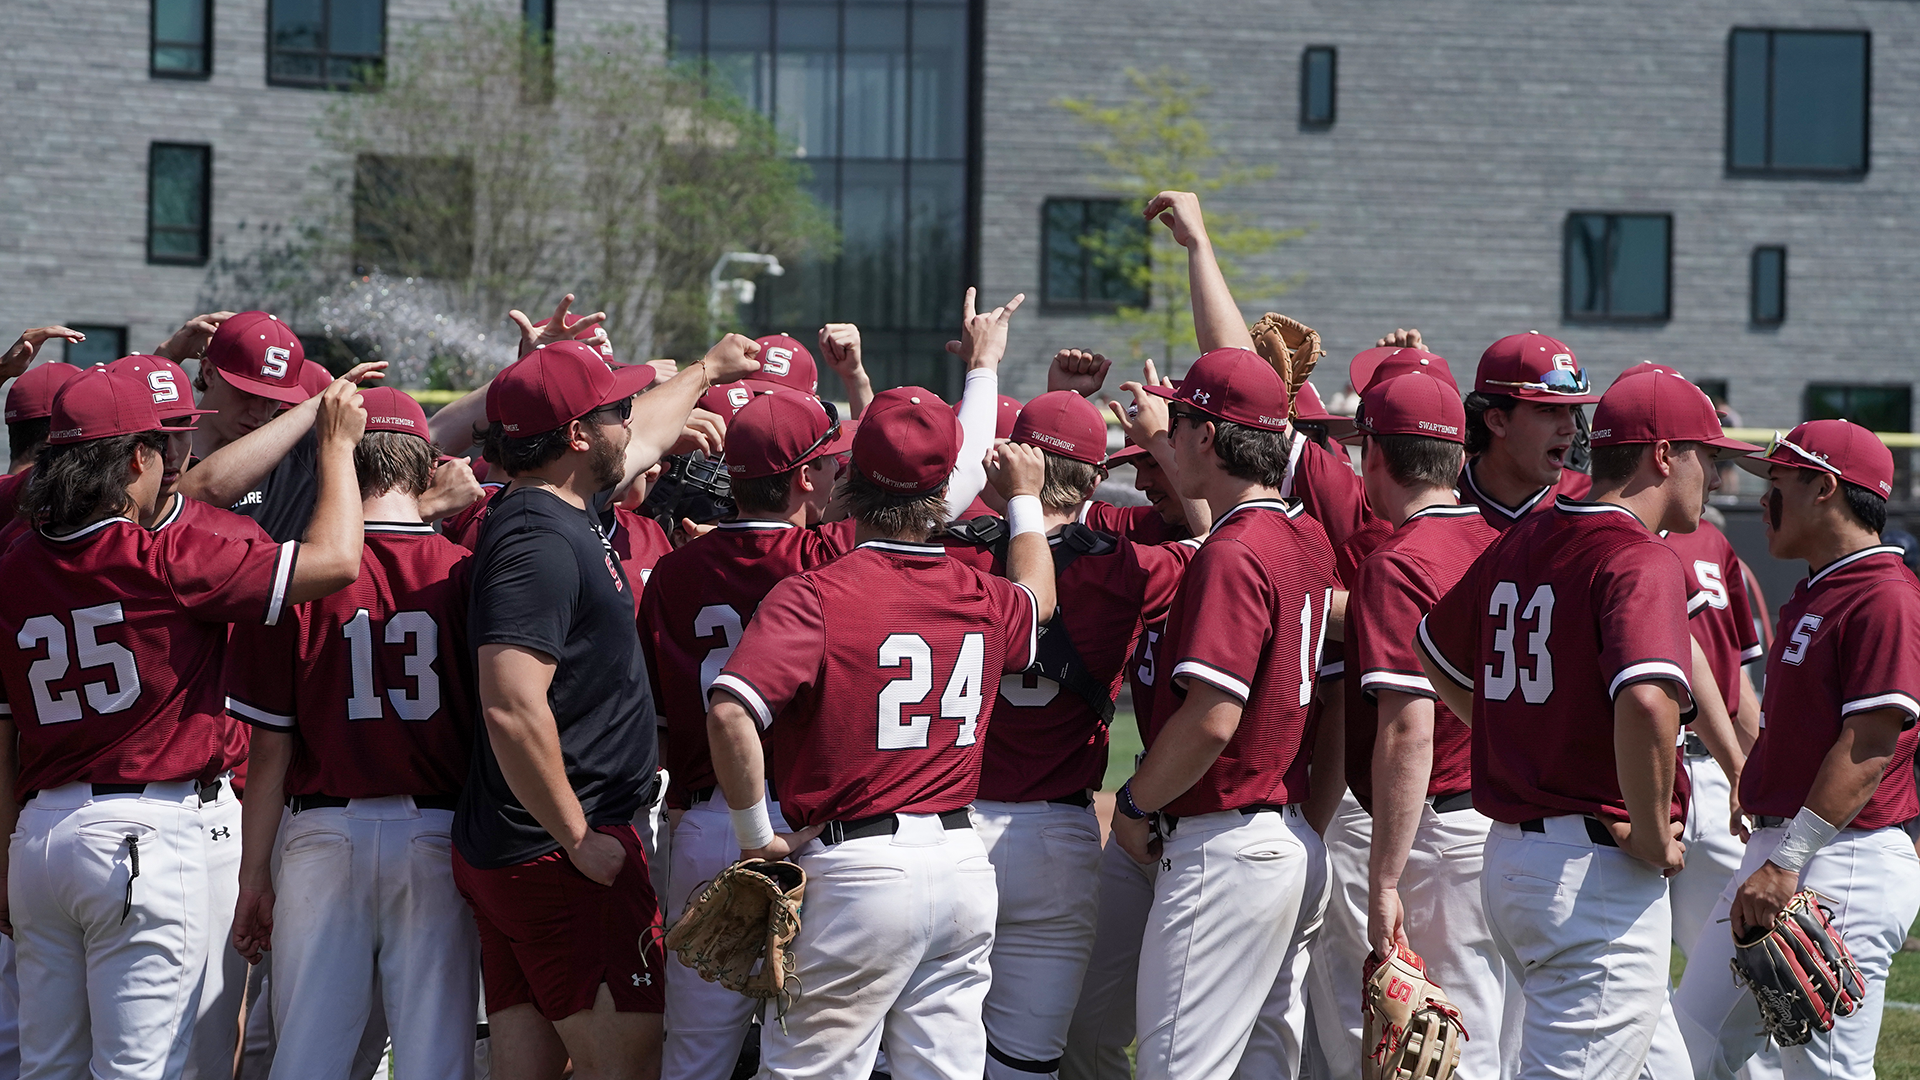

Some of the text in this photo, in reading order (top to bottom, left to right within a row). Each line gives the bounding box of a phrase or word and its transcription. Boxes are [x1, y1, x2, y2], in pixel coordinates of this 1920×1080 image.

[261, 346, 291, 380] S
[763, 346, 793, 377] S
[147, 370, 179, 404] S
[371, 416, 415, 428] SWARTHMORE
[1418, 420, 1458, 435] SWARTHMORE
[1031, 431, 1076, 452] SWARTHMORE
[872, 470, 918, 489] SWARTHMORE
[1693, 559, 1728, 610] S
[693, 601, 761, 713] 2
[1484, 580, 1555, 704] 33
[1781, 613, 1824, 666] S
[17, 601, 142, 725] 25
[342, 607, 441, 721] 13
[876, 631, 986, 751] 24
[1386, 976, 1414, 1005] S
[1761, 985, 1797, 1026] Rawlings
